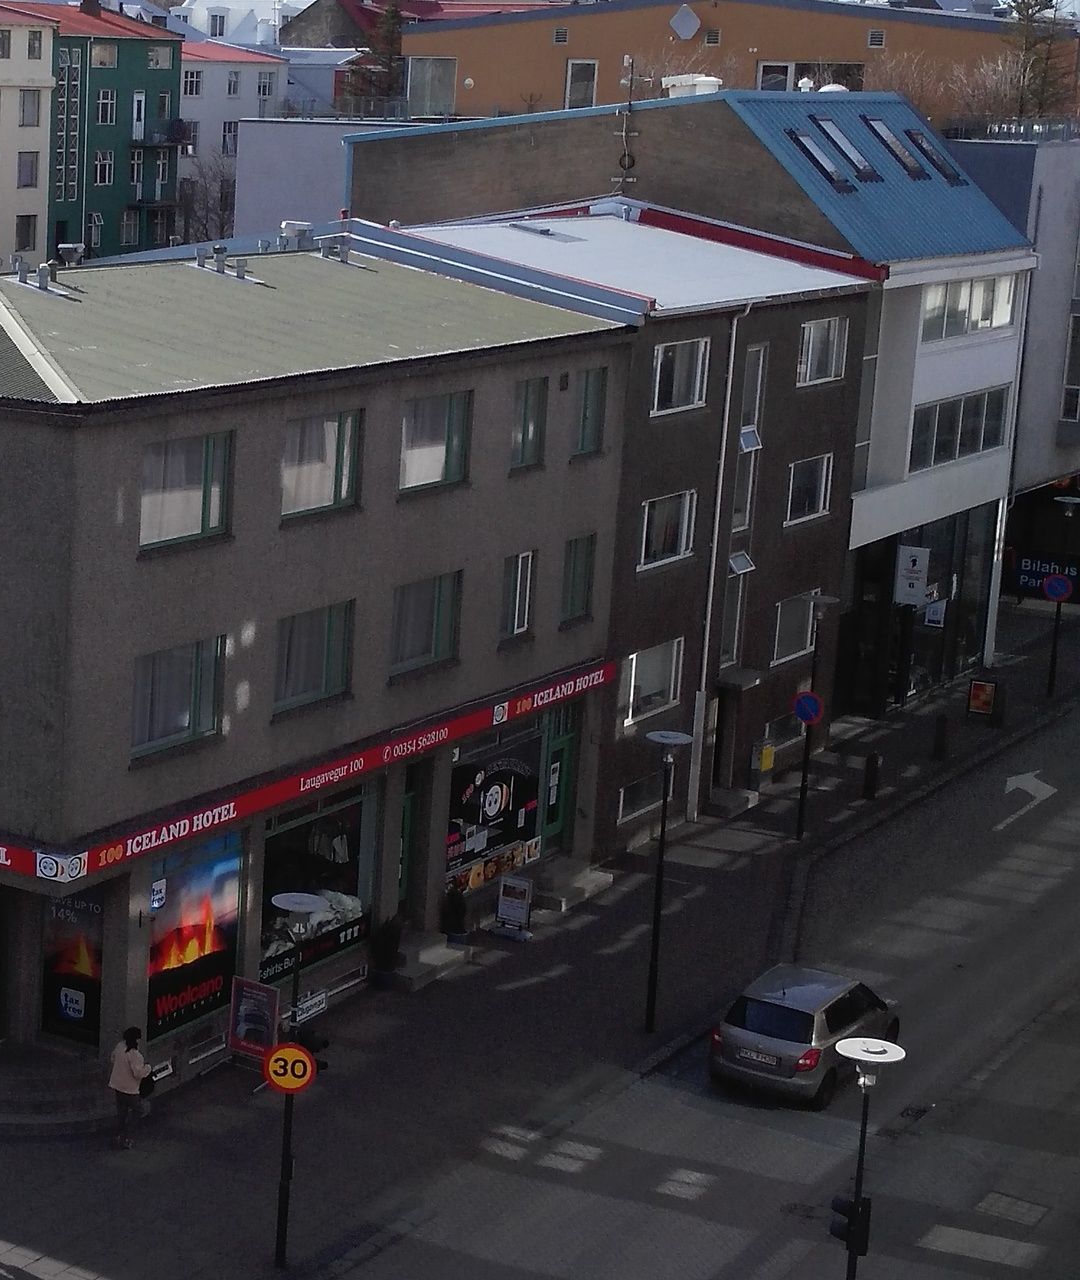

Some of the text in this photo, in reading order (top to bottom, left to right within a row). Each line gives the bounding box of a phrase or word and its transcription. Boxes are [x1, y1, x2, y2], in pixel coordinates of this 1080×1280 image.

[1019, 574, 1047, 587] Par
[515, 669, 605, 715] 100 ICELAND HOTEL
[299, 727, 449, 792] Laugavegur 100 00354 5628100
[98, 802, 238, 867] 100 ICELAND HOTEL
[51, 906, 78, 924] 14%
[74, 900, 87, 910] UP
[88, 903, 102, 914] TO
[155, 975, 224, 1020] Woolcano
[273, 1057, 307, 1079] 30
